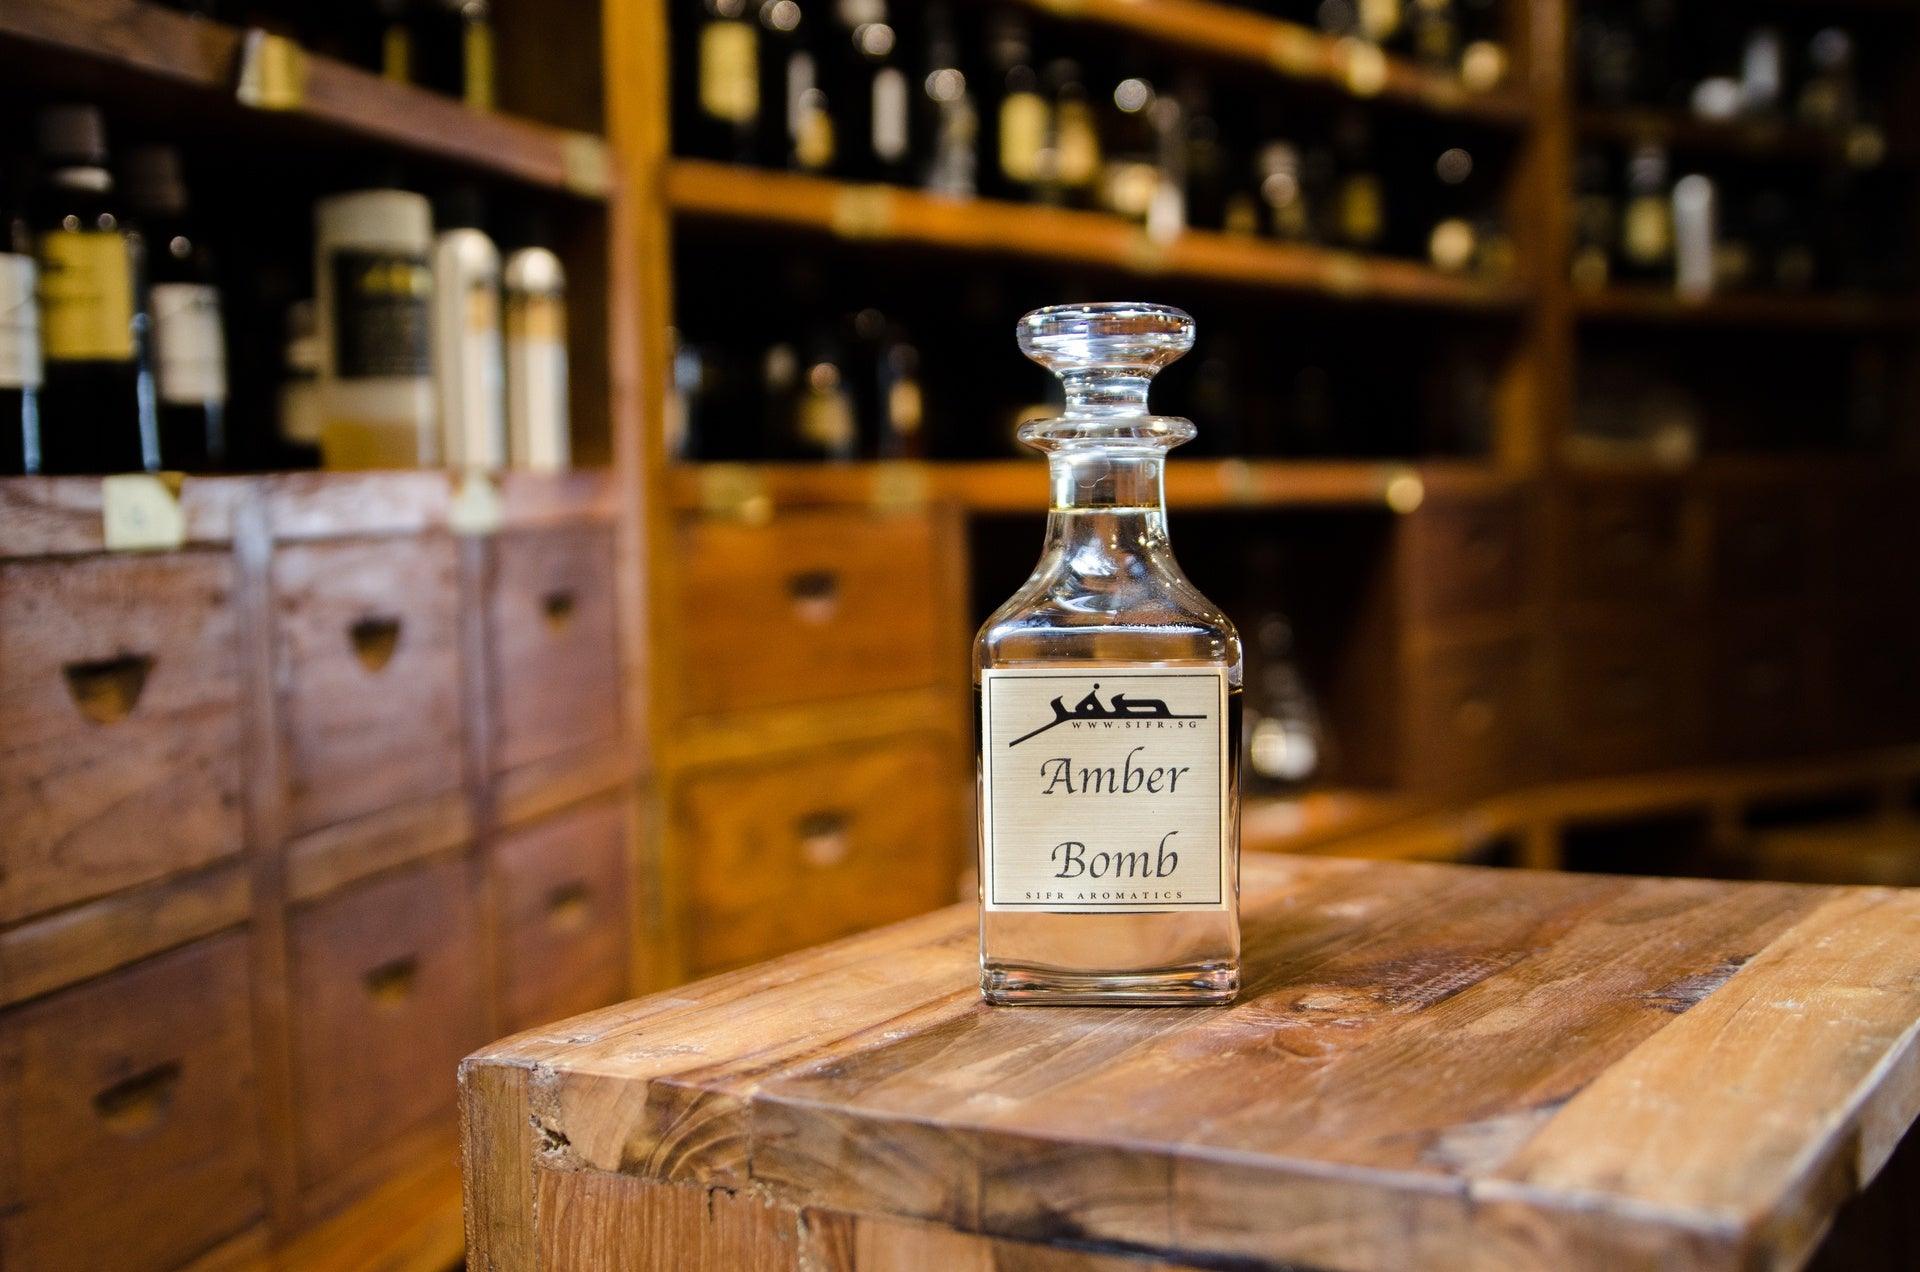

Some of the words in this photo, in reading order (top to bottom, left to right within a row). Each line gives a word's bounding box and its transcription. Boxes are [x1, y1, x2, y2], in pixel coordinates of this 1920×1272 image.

[1009, 682, 1207, 747] صفر
[1072, 720, 1198, 729] WWW.SIFR.SG
[1040, 746, 1190, 795] Amber
[1051, 830, 1179, 879] Bomb
[1026, 891, 1064, 900] SIFR
[1077, 891, 1183, 900] AROMATICS
